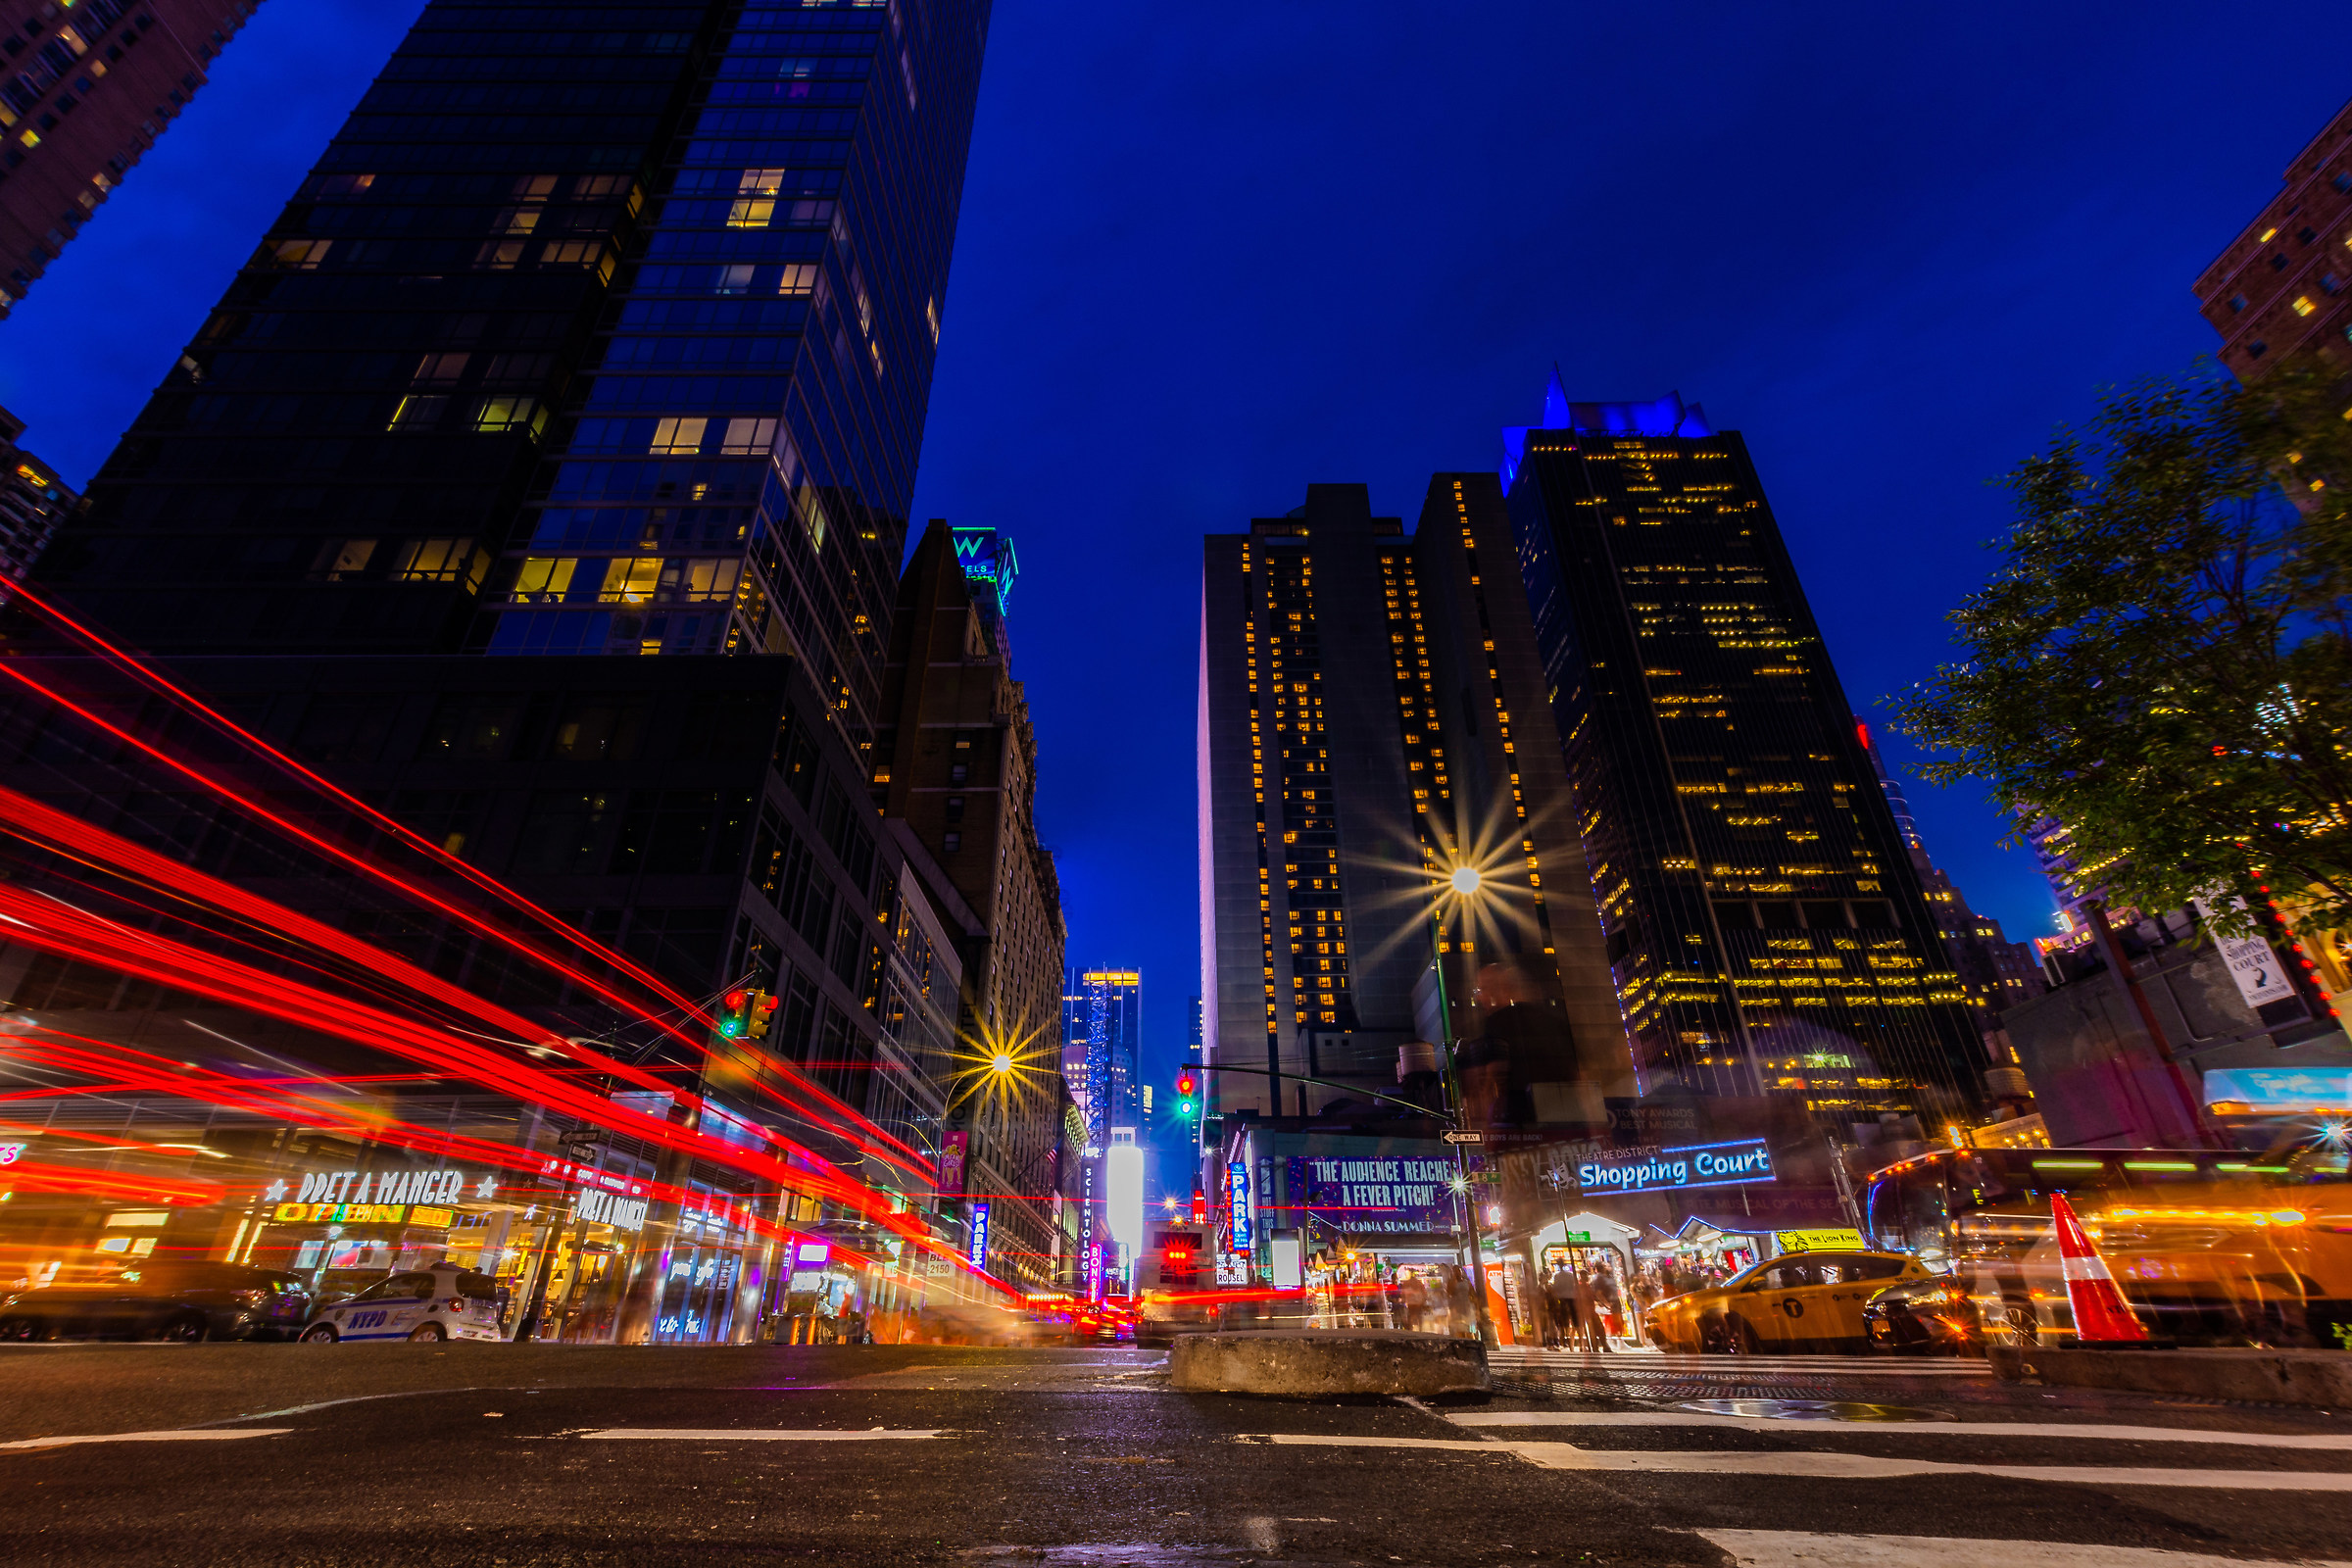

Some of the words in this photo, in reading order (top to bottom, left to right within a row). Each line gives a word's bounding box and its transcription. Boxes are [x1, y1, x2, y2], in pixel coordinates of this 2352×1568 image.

[954, 537, 984, 558] W
[1576, 1150, 1615, 1162] THEATRE
[1616, 1146, 1658, 1159] DISTRICT
[1342, 1160, 1400, 1182] AUDIENCE
[1580, 1156, 1687, 1189] Shopping
[1695, 1148, 1769, 1175] Court
[296, 1172, 357, 1204] PRET
[352, 1172, 372, 1204] A
[374, 1171, 464, 1204] MANGER
[1343, 1186, 1351, 1206] A
[1353, 1186, 1392, 1206] FEVER
[1232, 1175, 1248, 1233] PARK
[1082, 1167, 1092, 1283] SCIENTOLOGY
[1343, 1221, 1382, 1232] DONNA
[1384, 1220, 1435, 1233] SUMMER
[971, 1212, 986, 1265] PARKI
[1822, 1235, 1839, 1244] LION
[1839, 1234, 1859, 1243] KING
[348, 1309, 388, 1330] NYPD
